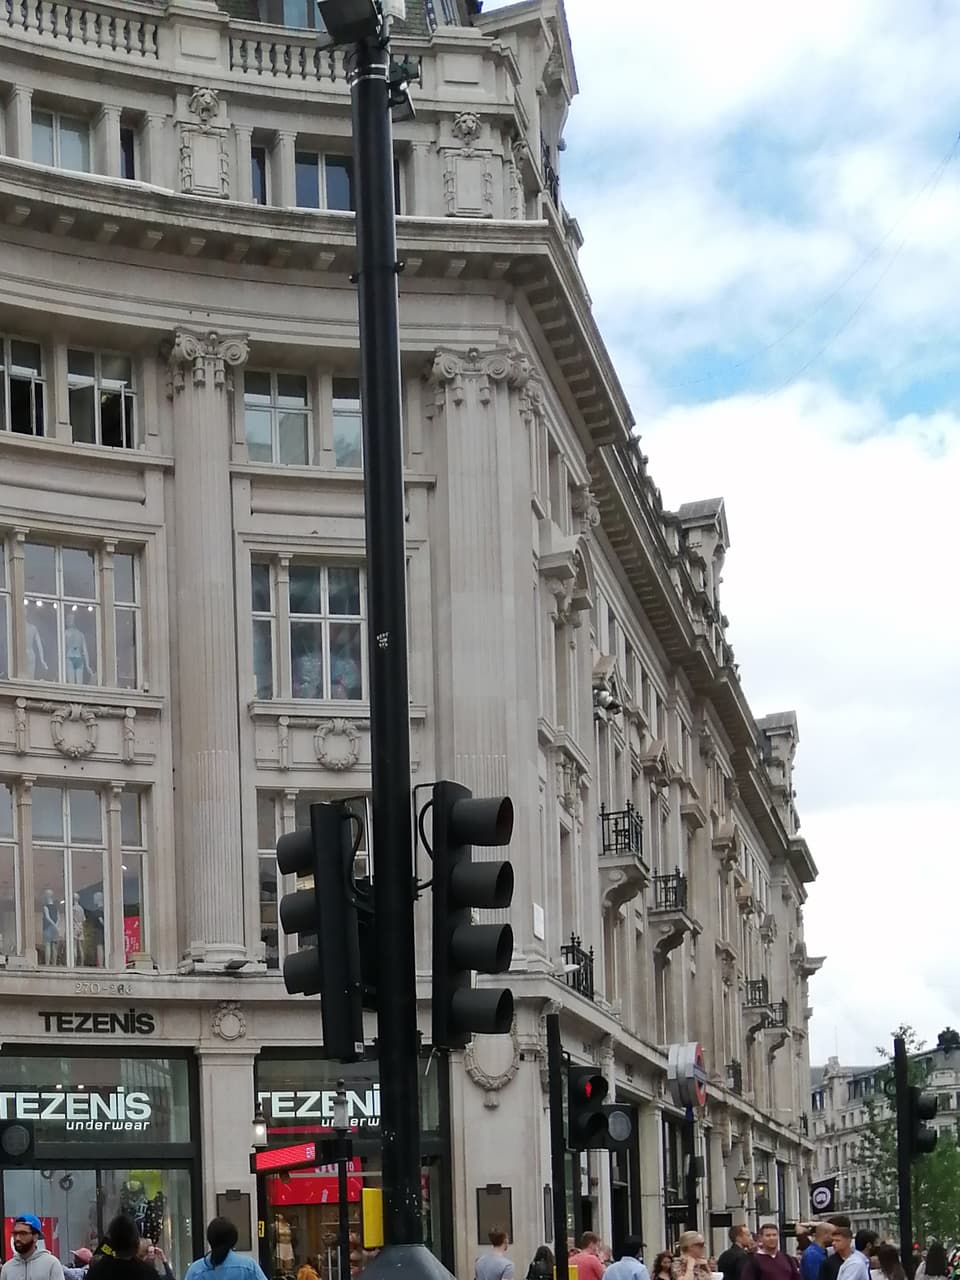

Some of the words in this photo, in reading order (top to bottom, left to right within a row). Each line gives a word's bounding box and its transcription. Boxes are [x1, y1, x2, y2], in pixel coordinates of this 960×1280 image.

[38, 1008, 155, 1034] TEZENIS
[257, 1083, 381, 1117] TEZENI
[66, 1121, 150, 1131] underwear
